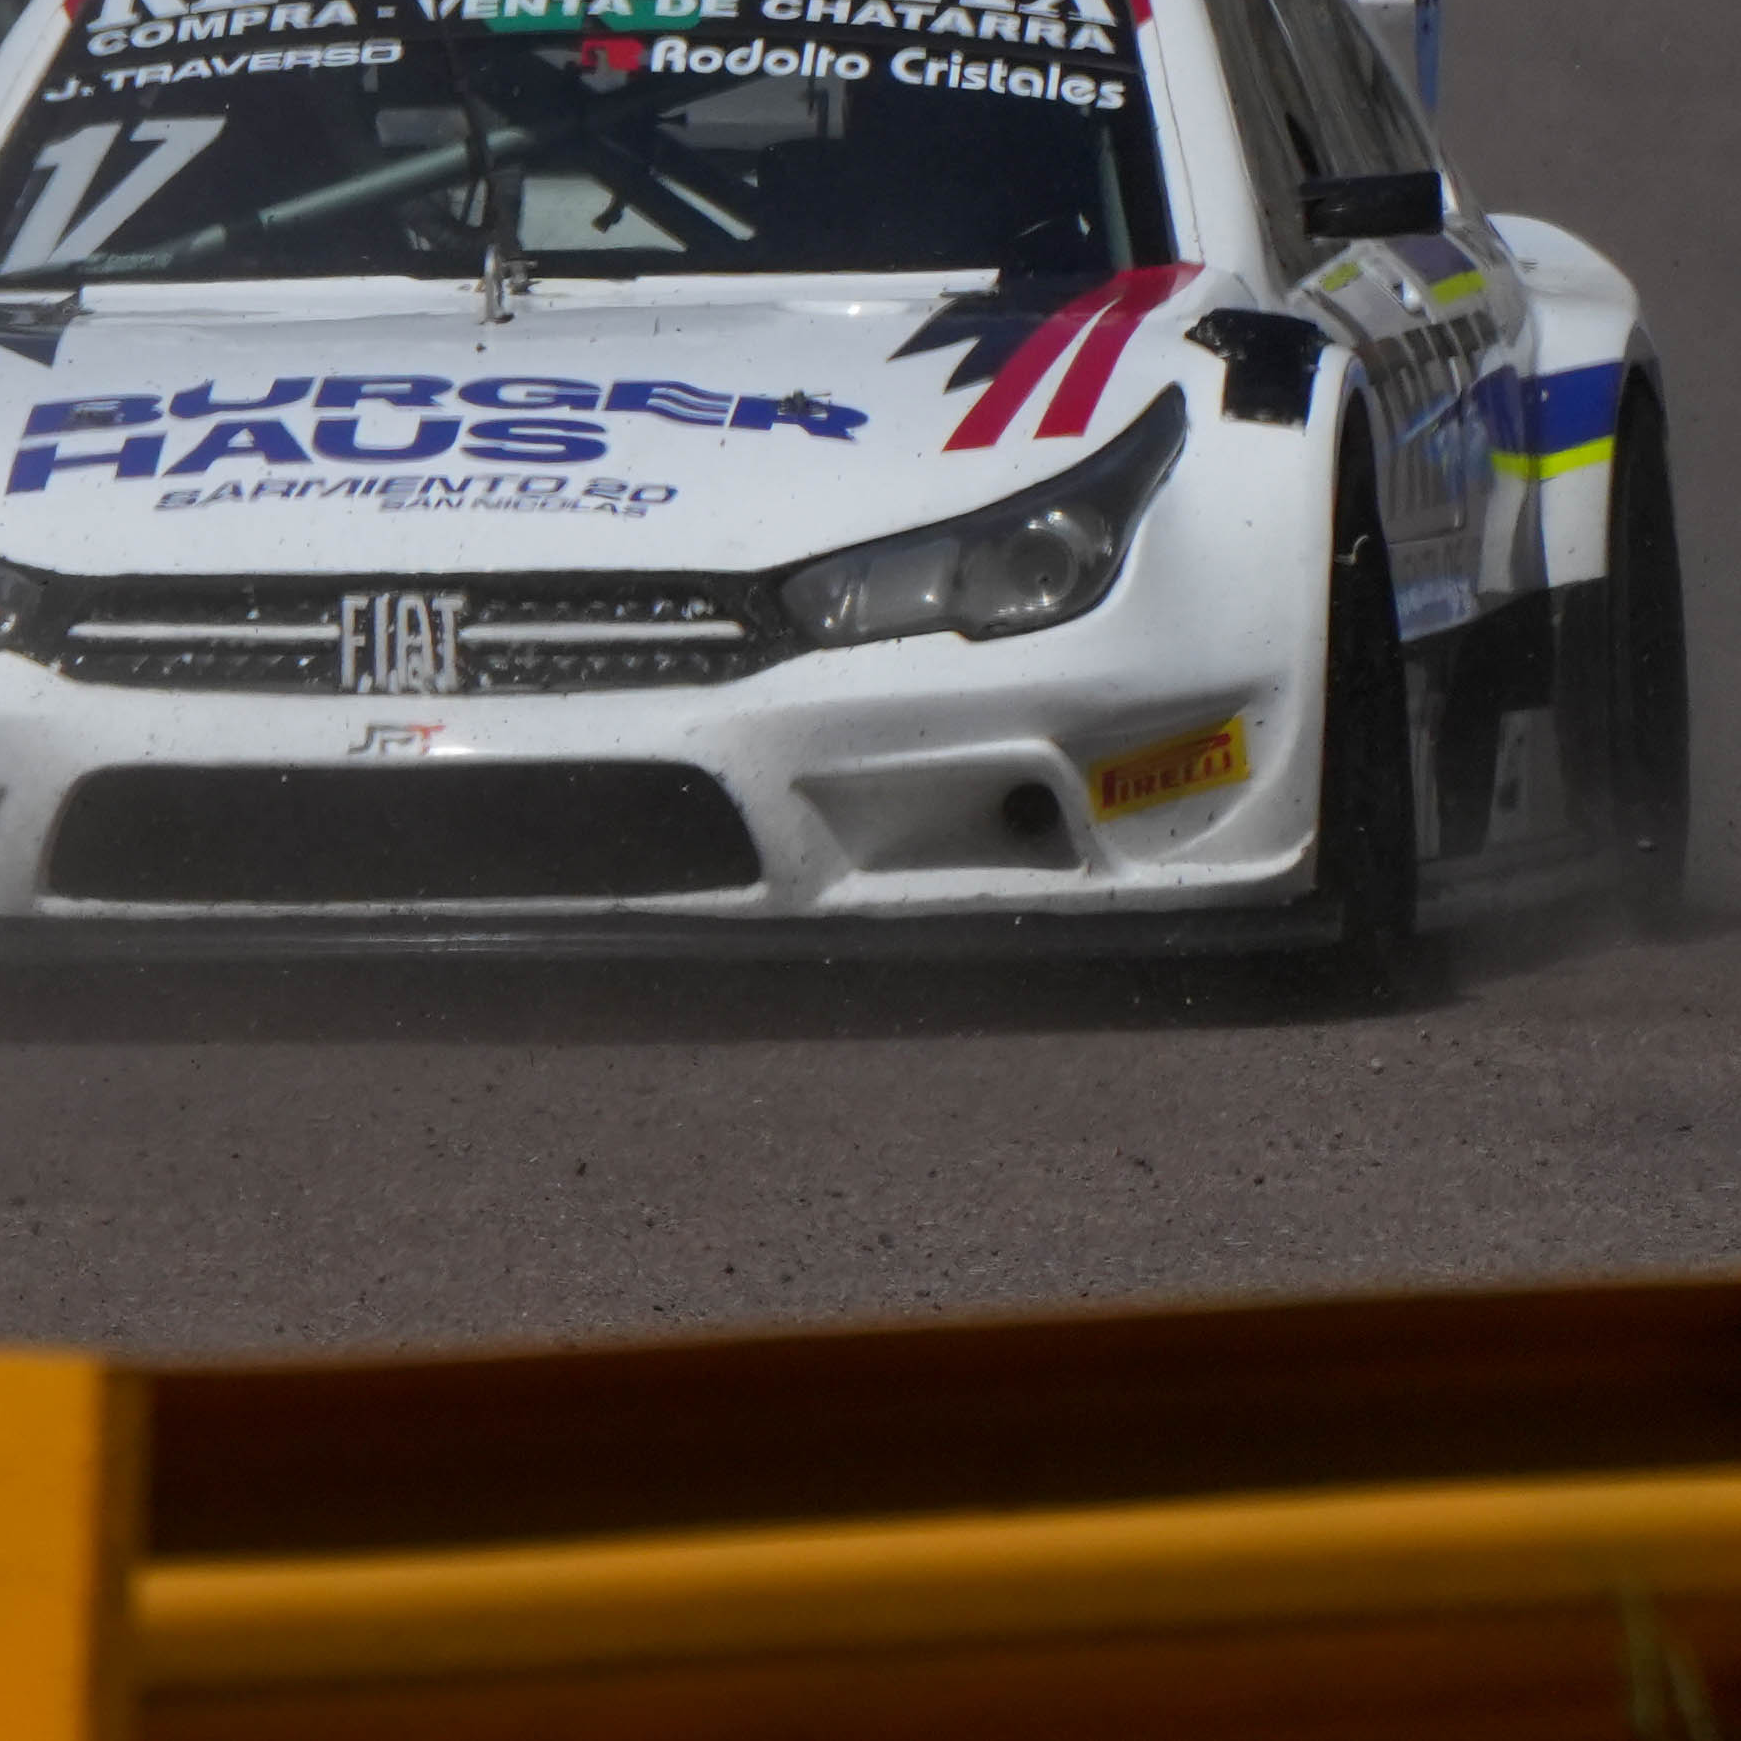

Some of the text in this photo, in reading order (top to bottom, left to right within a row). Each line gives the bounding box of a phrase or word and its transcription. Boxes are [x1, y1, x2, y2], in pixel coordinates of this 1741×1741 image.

[87, 0, 357, 57] COMPRA
[43, 38, 404, 103] J. TRAVERSO
[652, 36, 1125, 111] Rodolfo Cristales
[24, 375, 869, 441] BURGER
[6, 414, 608, 496] HAUS
[154, 475, 678, 511] SARMIENTO 20
[379, 494, 649, 519] SAN NICOLAS
[341, 593, 467, 693] FIAT
[1101, 732, 1234, 810] PIRELLI
